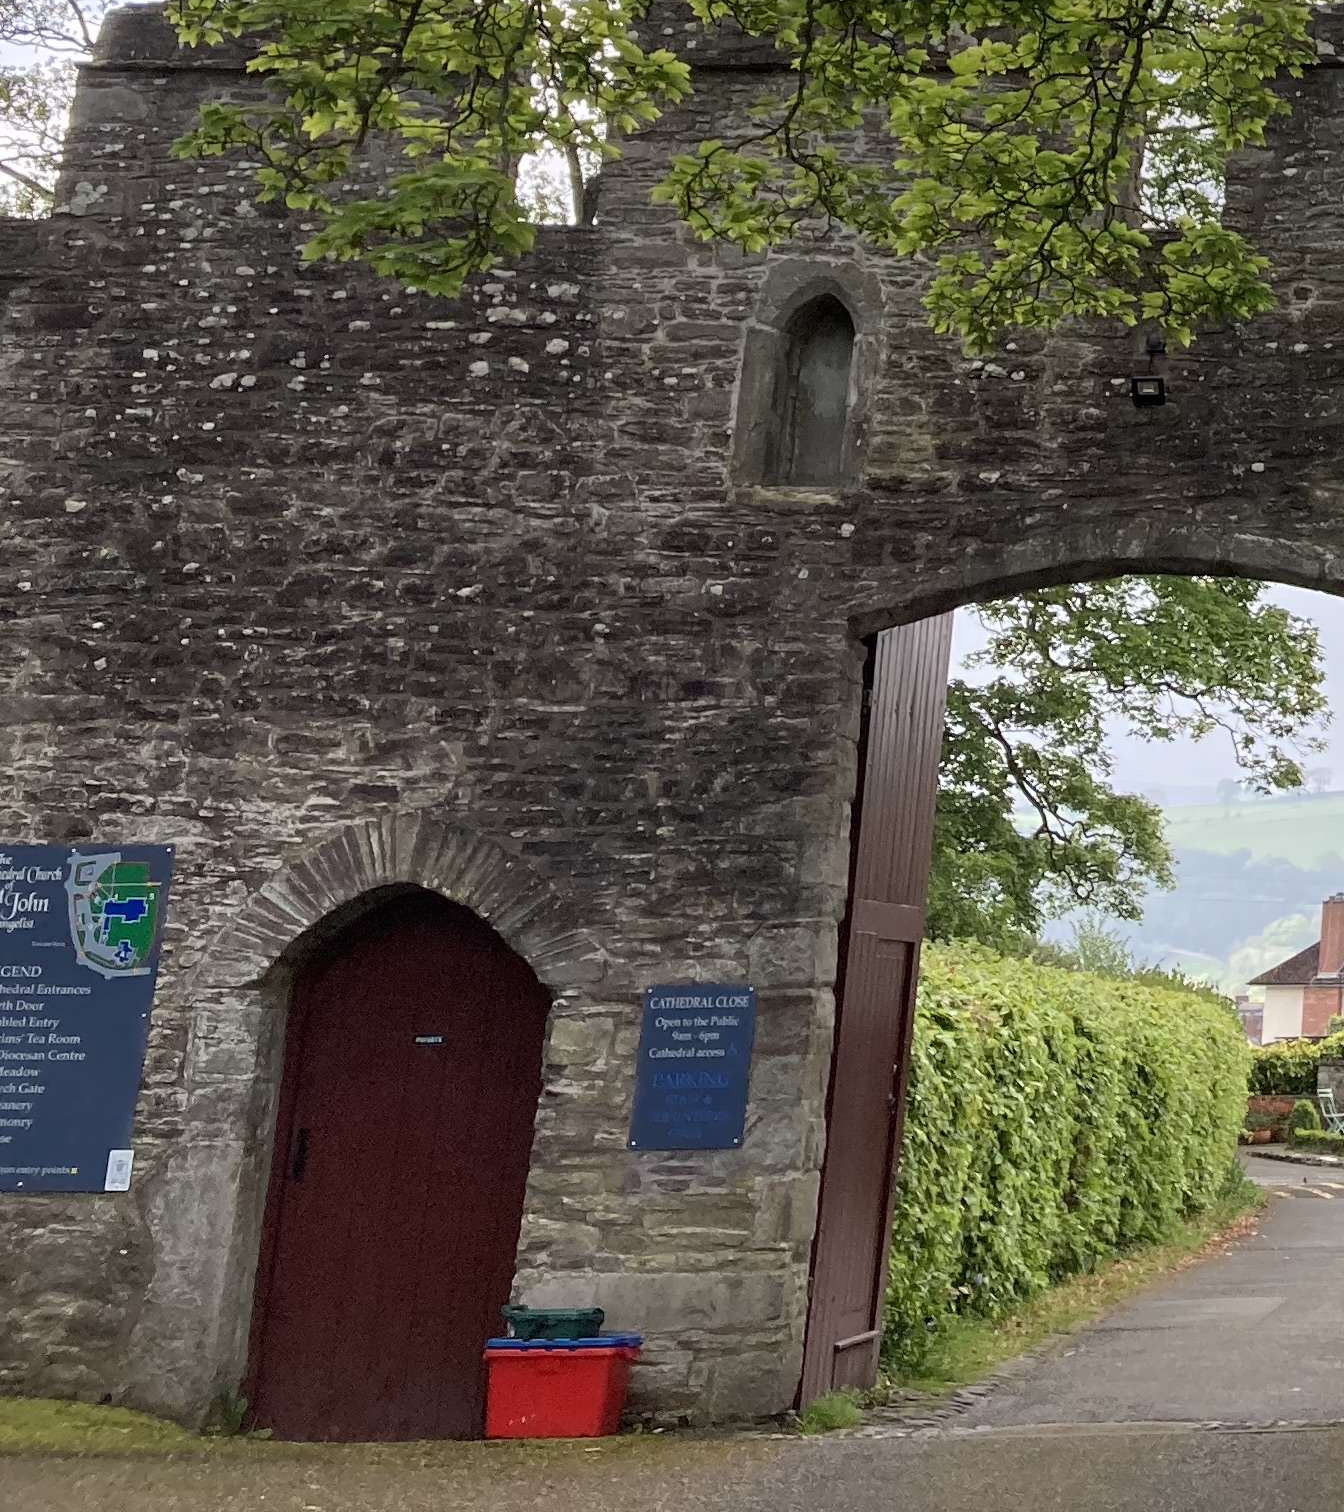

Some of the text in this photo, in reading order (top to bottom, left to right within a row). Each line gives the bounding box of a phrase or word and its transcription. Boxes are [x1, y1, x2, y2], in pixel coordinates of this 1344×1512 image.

[27, 866, 62, 884] Church
[1, 892, 49, 920] John
[36, 984, 92, 995] Entrances
[15, 1000, 45, 1011] Door
[650, 996, 750, 1009] CATHEDRAL CLOSE
[29, 1017, 60, 1030] Entry
[655, 1016, 740, 1030] Open to the Public
[26, 1033, 46, 1044] Tea
[48, 1033, 81, 1044] Room
[671, 1031, 692, 1041] 9am
[699, 1031, 720, 1043] 6pm
[48, 1049, 86, 1061] Centre
[649, 1047, 726, 1058] Cathedral access
[18, 1083, 46, 1094] Gate
